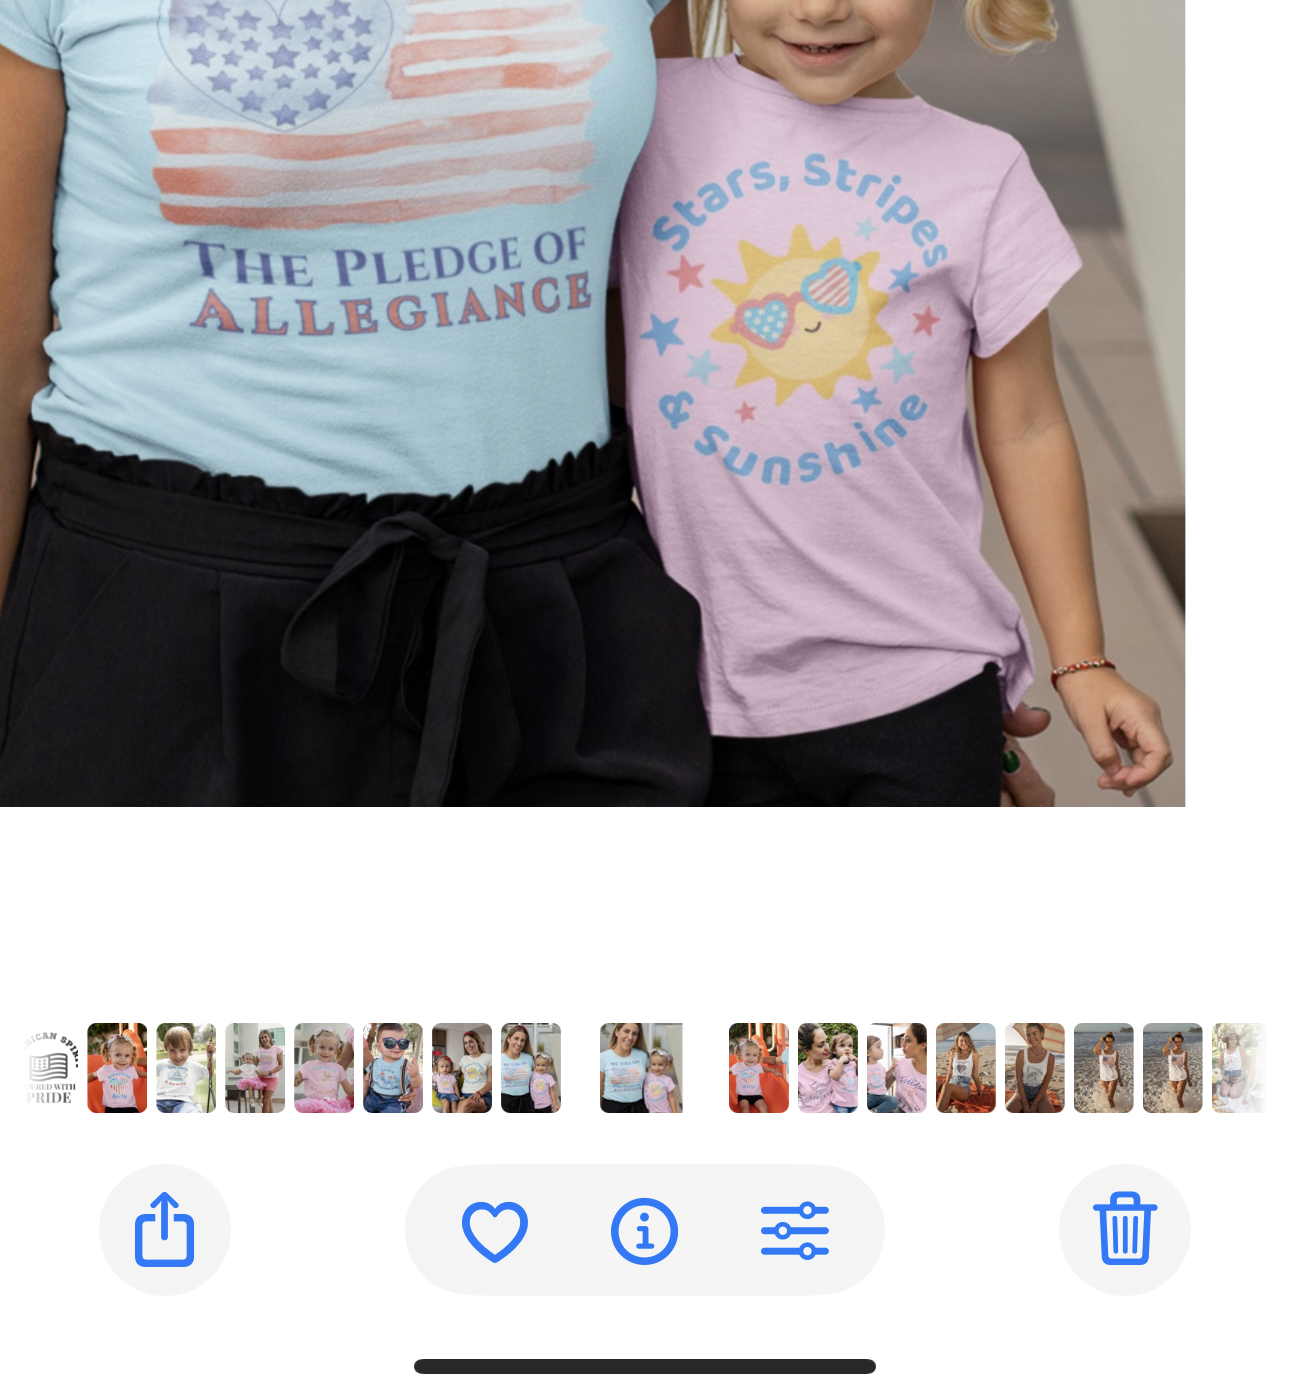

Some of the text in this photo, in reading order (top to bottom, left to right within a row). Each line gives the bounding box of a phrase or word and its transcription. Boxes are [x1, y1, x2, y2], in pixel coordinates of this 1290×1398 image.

[652, 153, 948, 269] Stars, Stripes
[183, 227, 587, 287] THE PLEDGE OF
[189, 271, 592, 336] ALLEGIANCE
[658, 390, 928, 486] & Sunshine
[24, 1032, 58, 1051] RICAN
[26, 1091, 72, 1104] PRIDE
[53, 1083, 76, 1091] WITH
